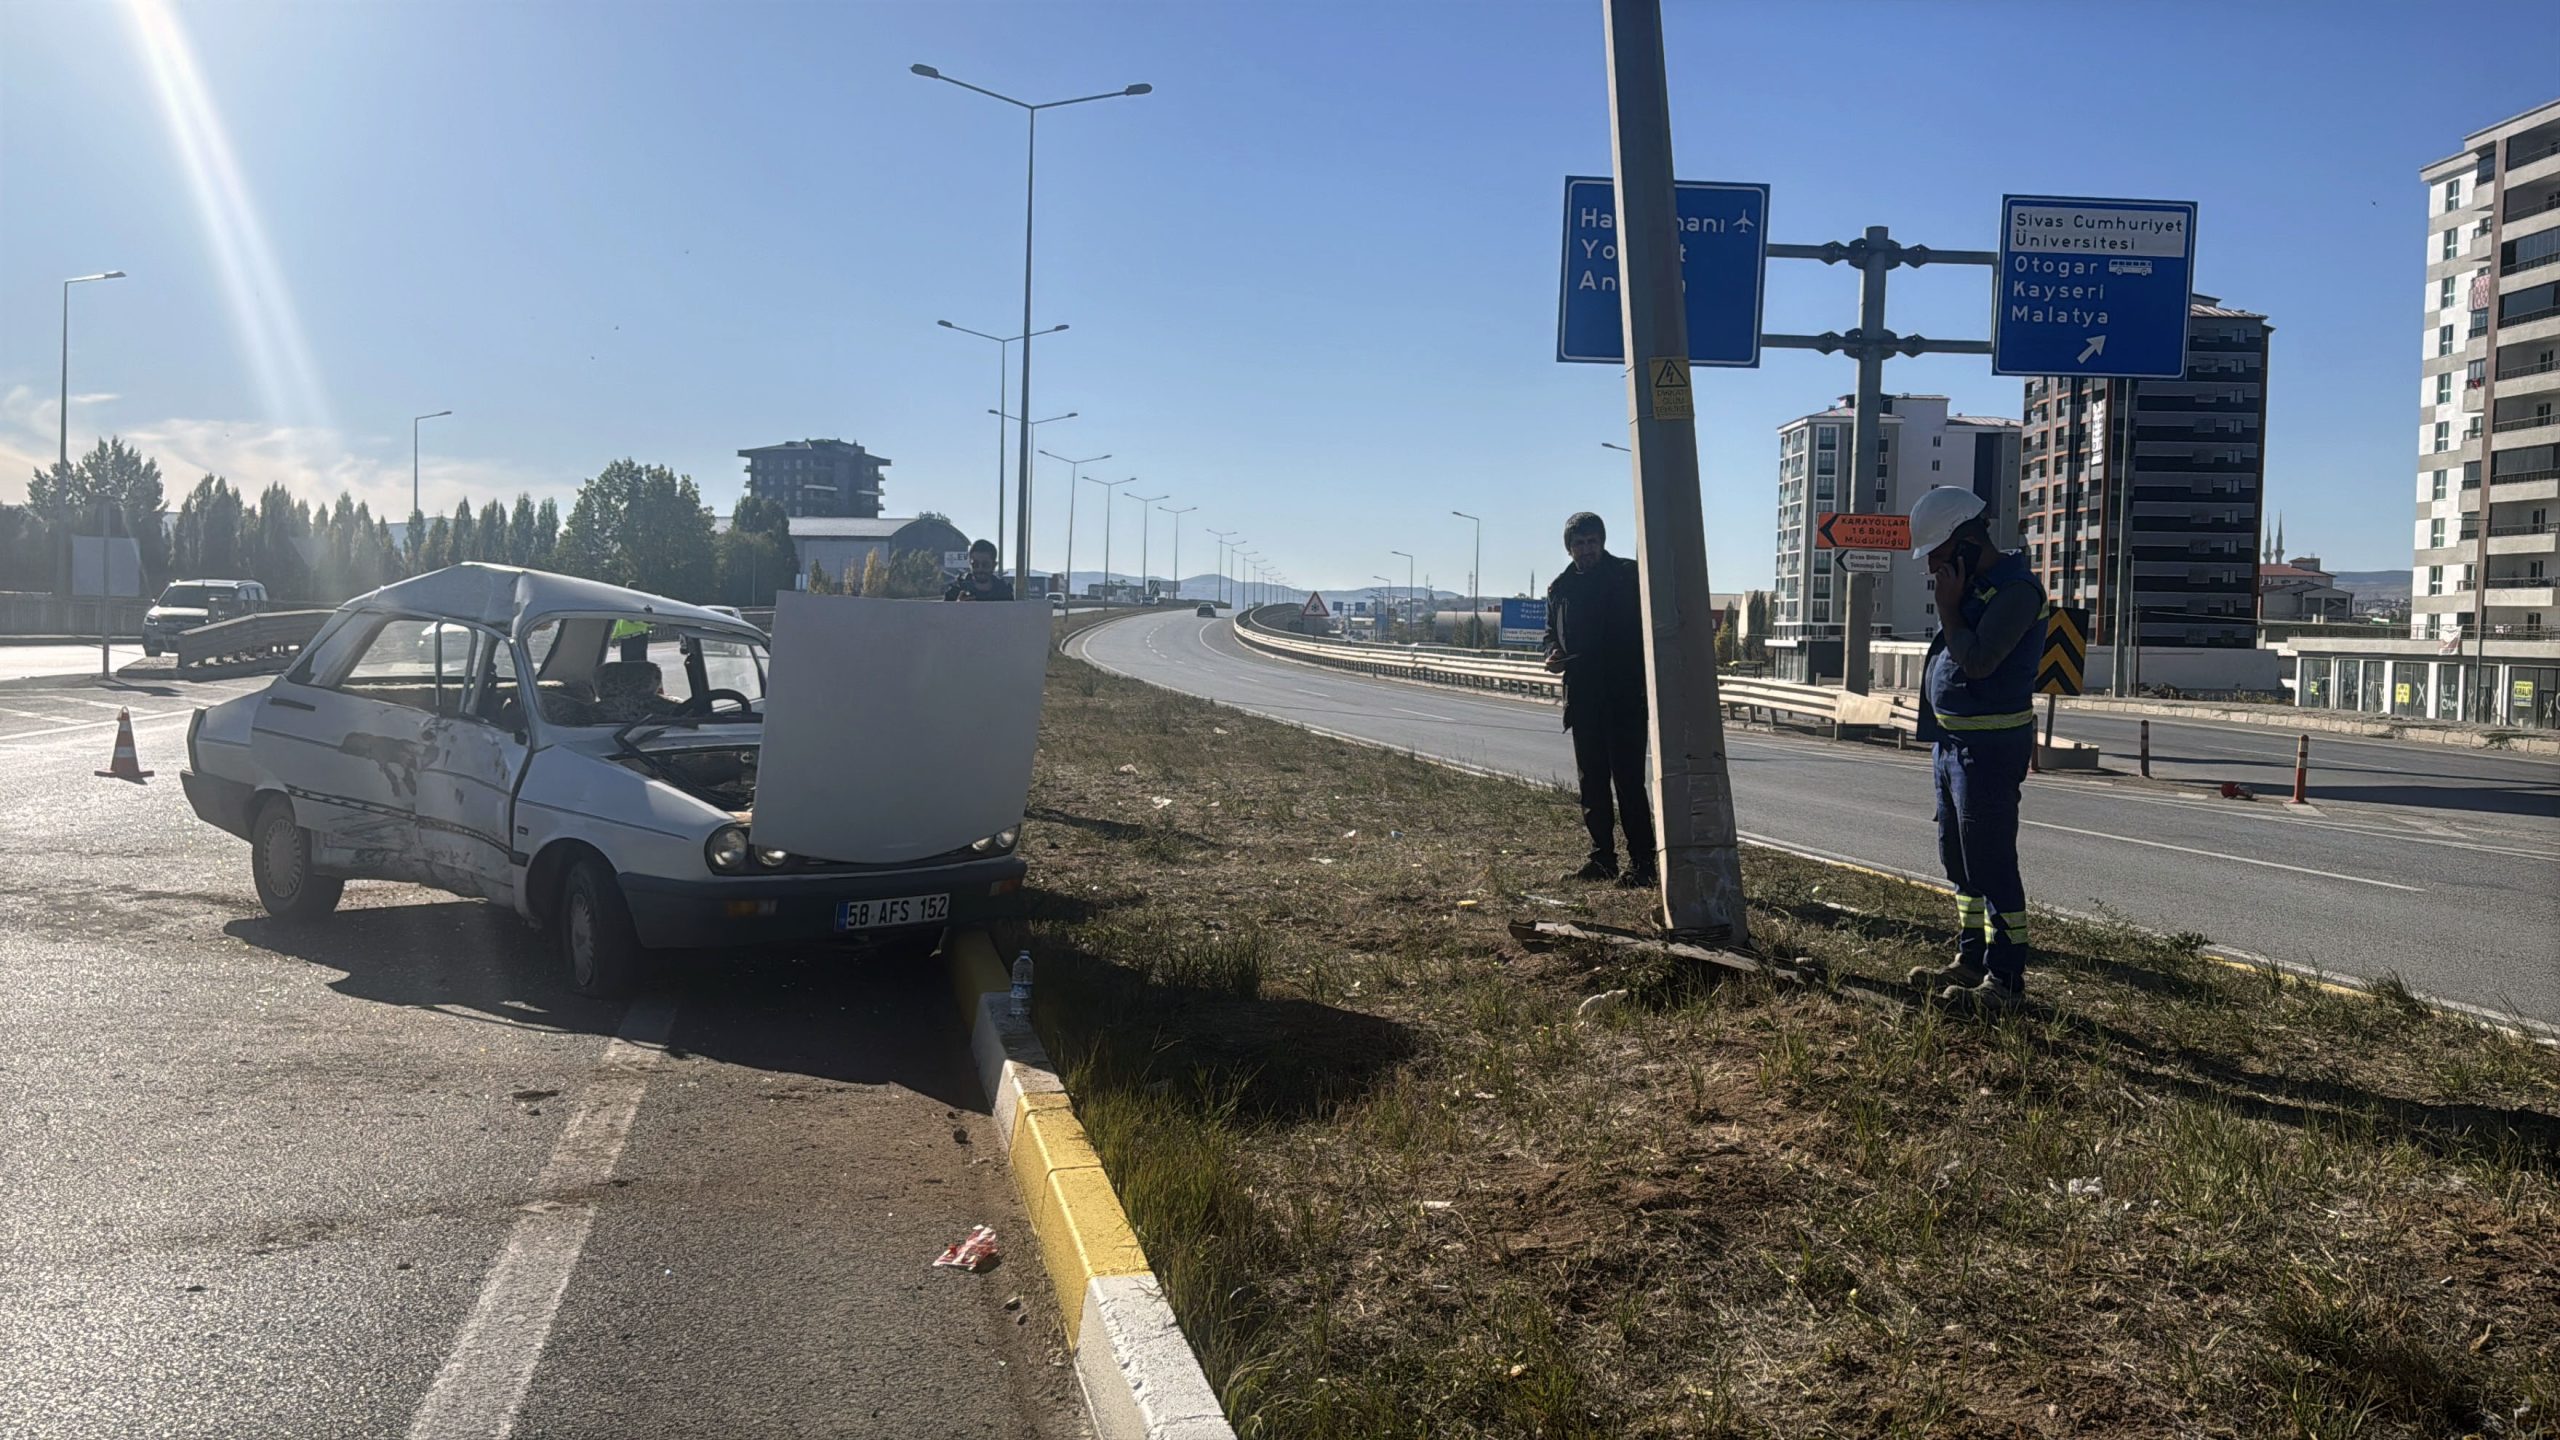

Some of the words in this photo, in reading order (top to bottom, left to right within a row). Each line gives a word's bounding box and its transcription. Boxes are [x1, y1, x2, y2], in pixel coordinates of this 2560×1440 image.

[2016, 213, 2064, 228] Sivas
[2074, 215, 2183, 234] Cumhuriyet
[2015, 230, 2136, 250] Üniversitesi
[2014, 255, 2099, 278] Otogar
[2013, 281, 2105, 302] Kayseri
[2011, 305, 2109, 328] Malatya
[1841, 518, 1910, 527] KARAYOLLARI
[847, 903, 870, 927] 58
[878, 900, 909, 924] AFS
[920, 896, 947, 919] 152
